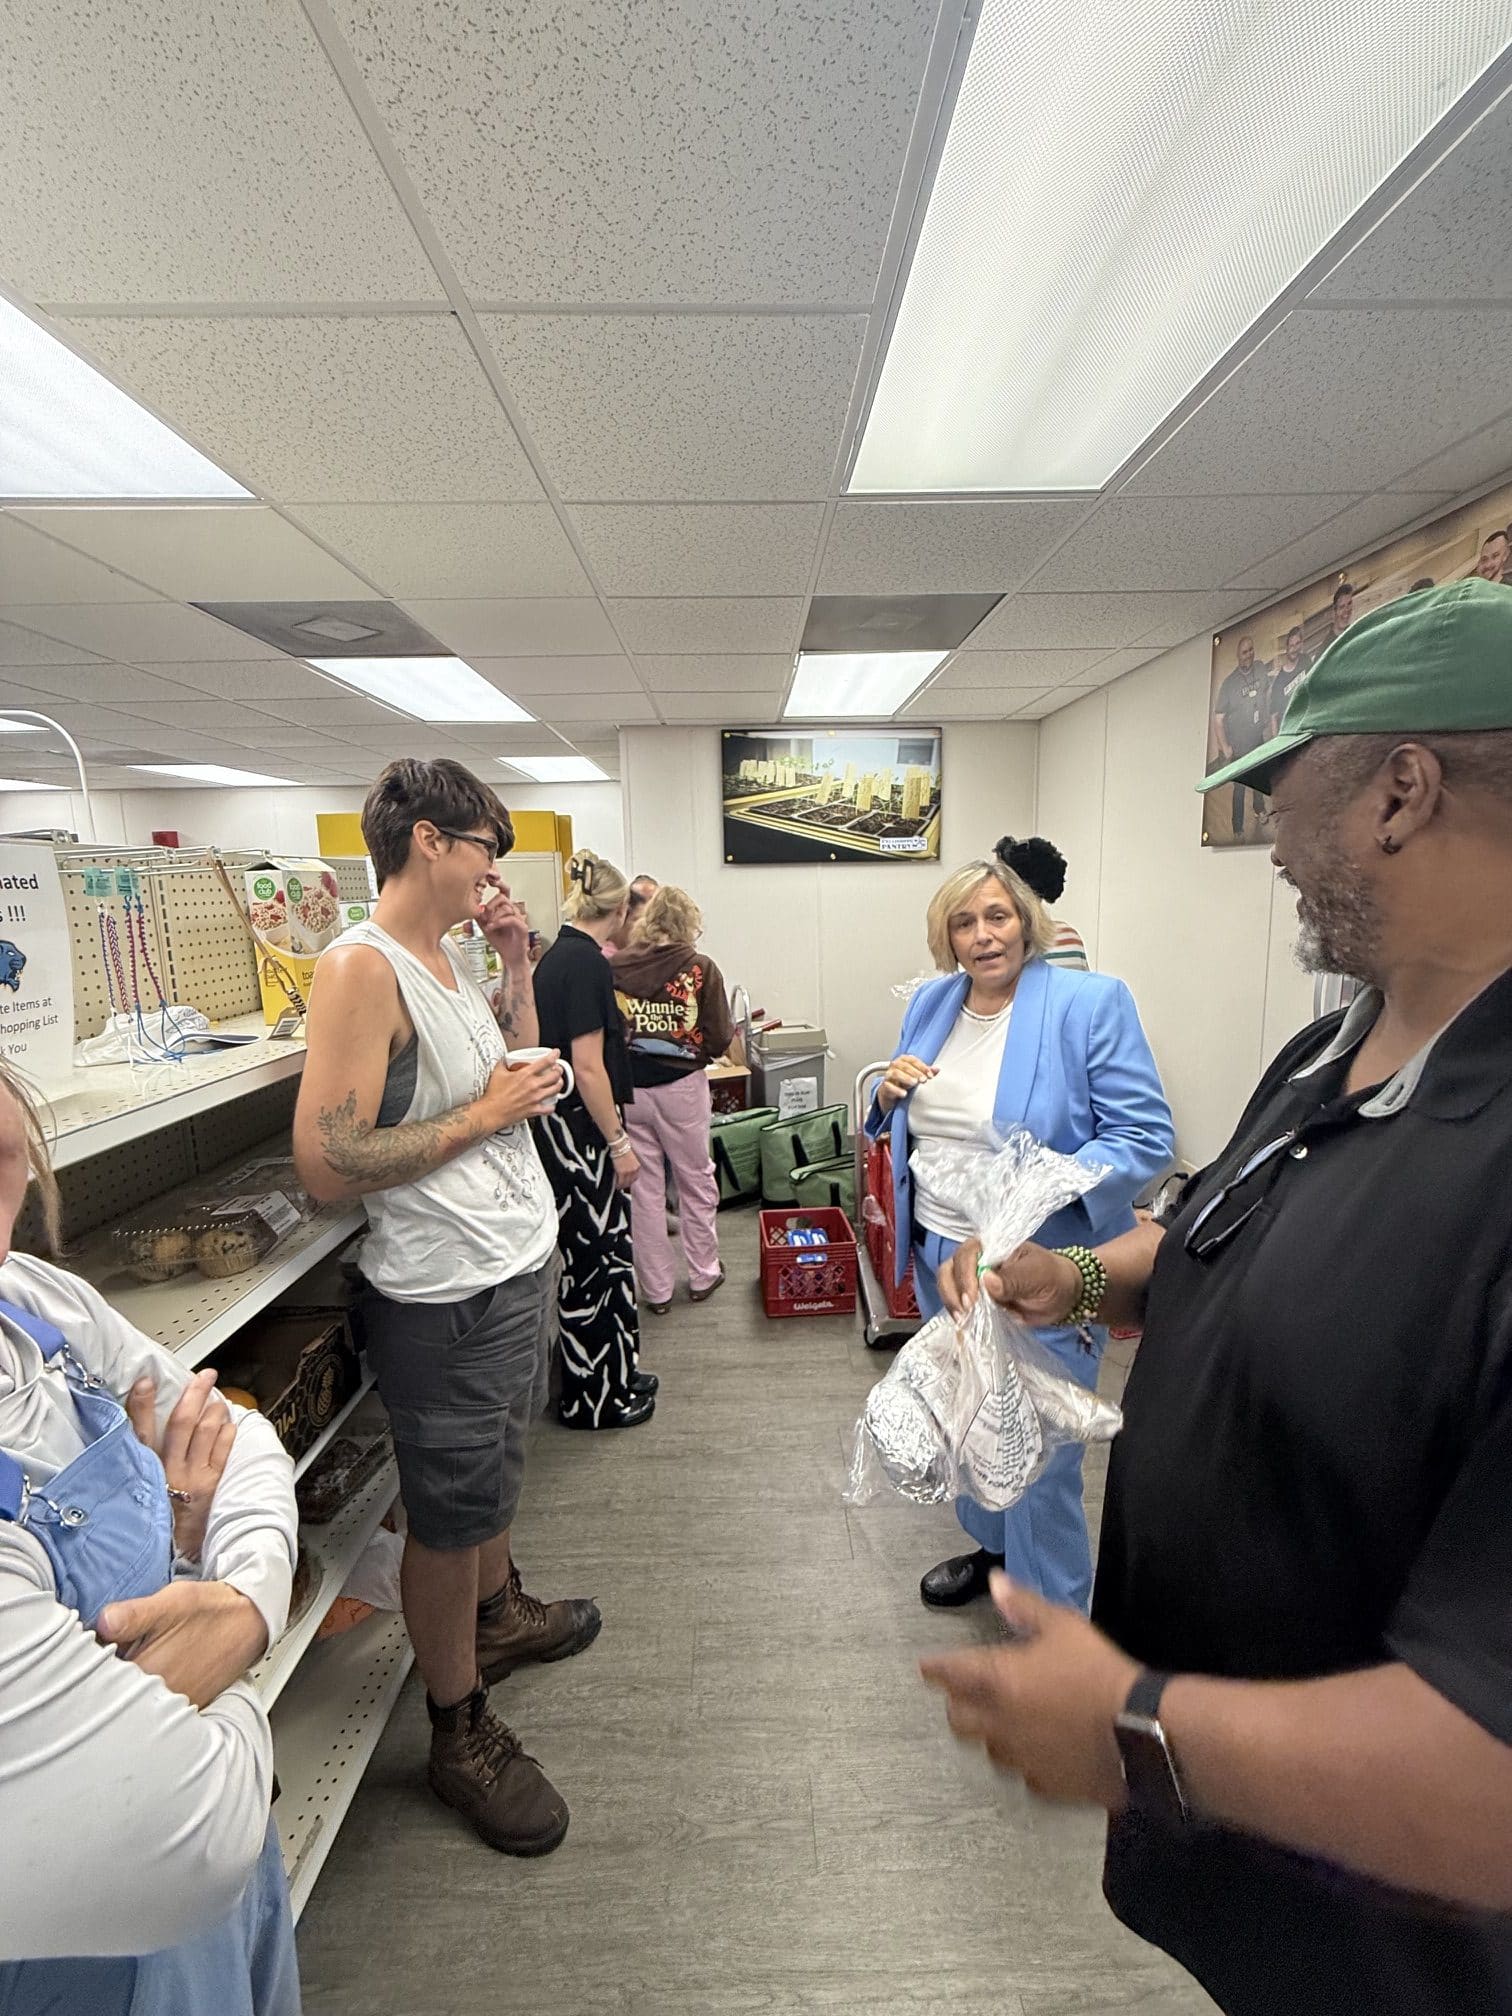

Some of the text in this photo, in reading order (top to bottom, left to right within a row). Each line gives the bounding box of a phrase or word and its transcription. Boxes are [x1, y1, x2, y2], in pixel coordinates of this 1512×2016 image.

[12, 1000, 40, 1012] Items
[42, 997, 52, 1007] at
[626, 998, 684, 1016] Winnie
[43, 1014, 58, 1026] List
[635, 1014, 678, 1032] Pooh
[650, 1013, 663, 1021] the
[8, 1043, 27, 1054] You
